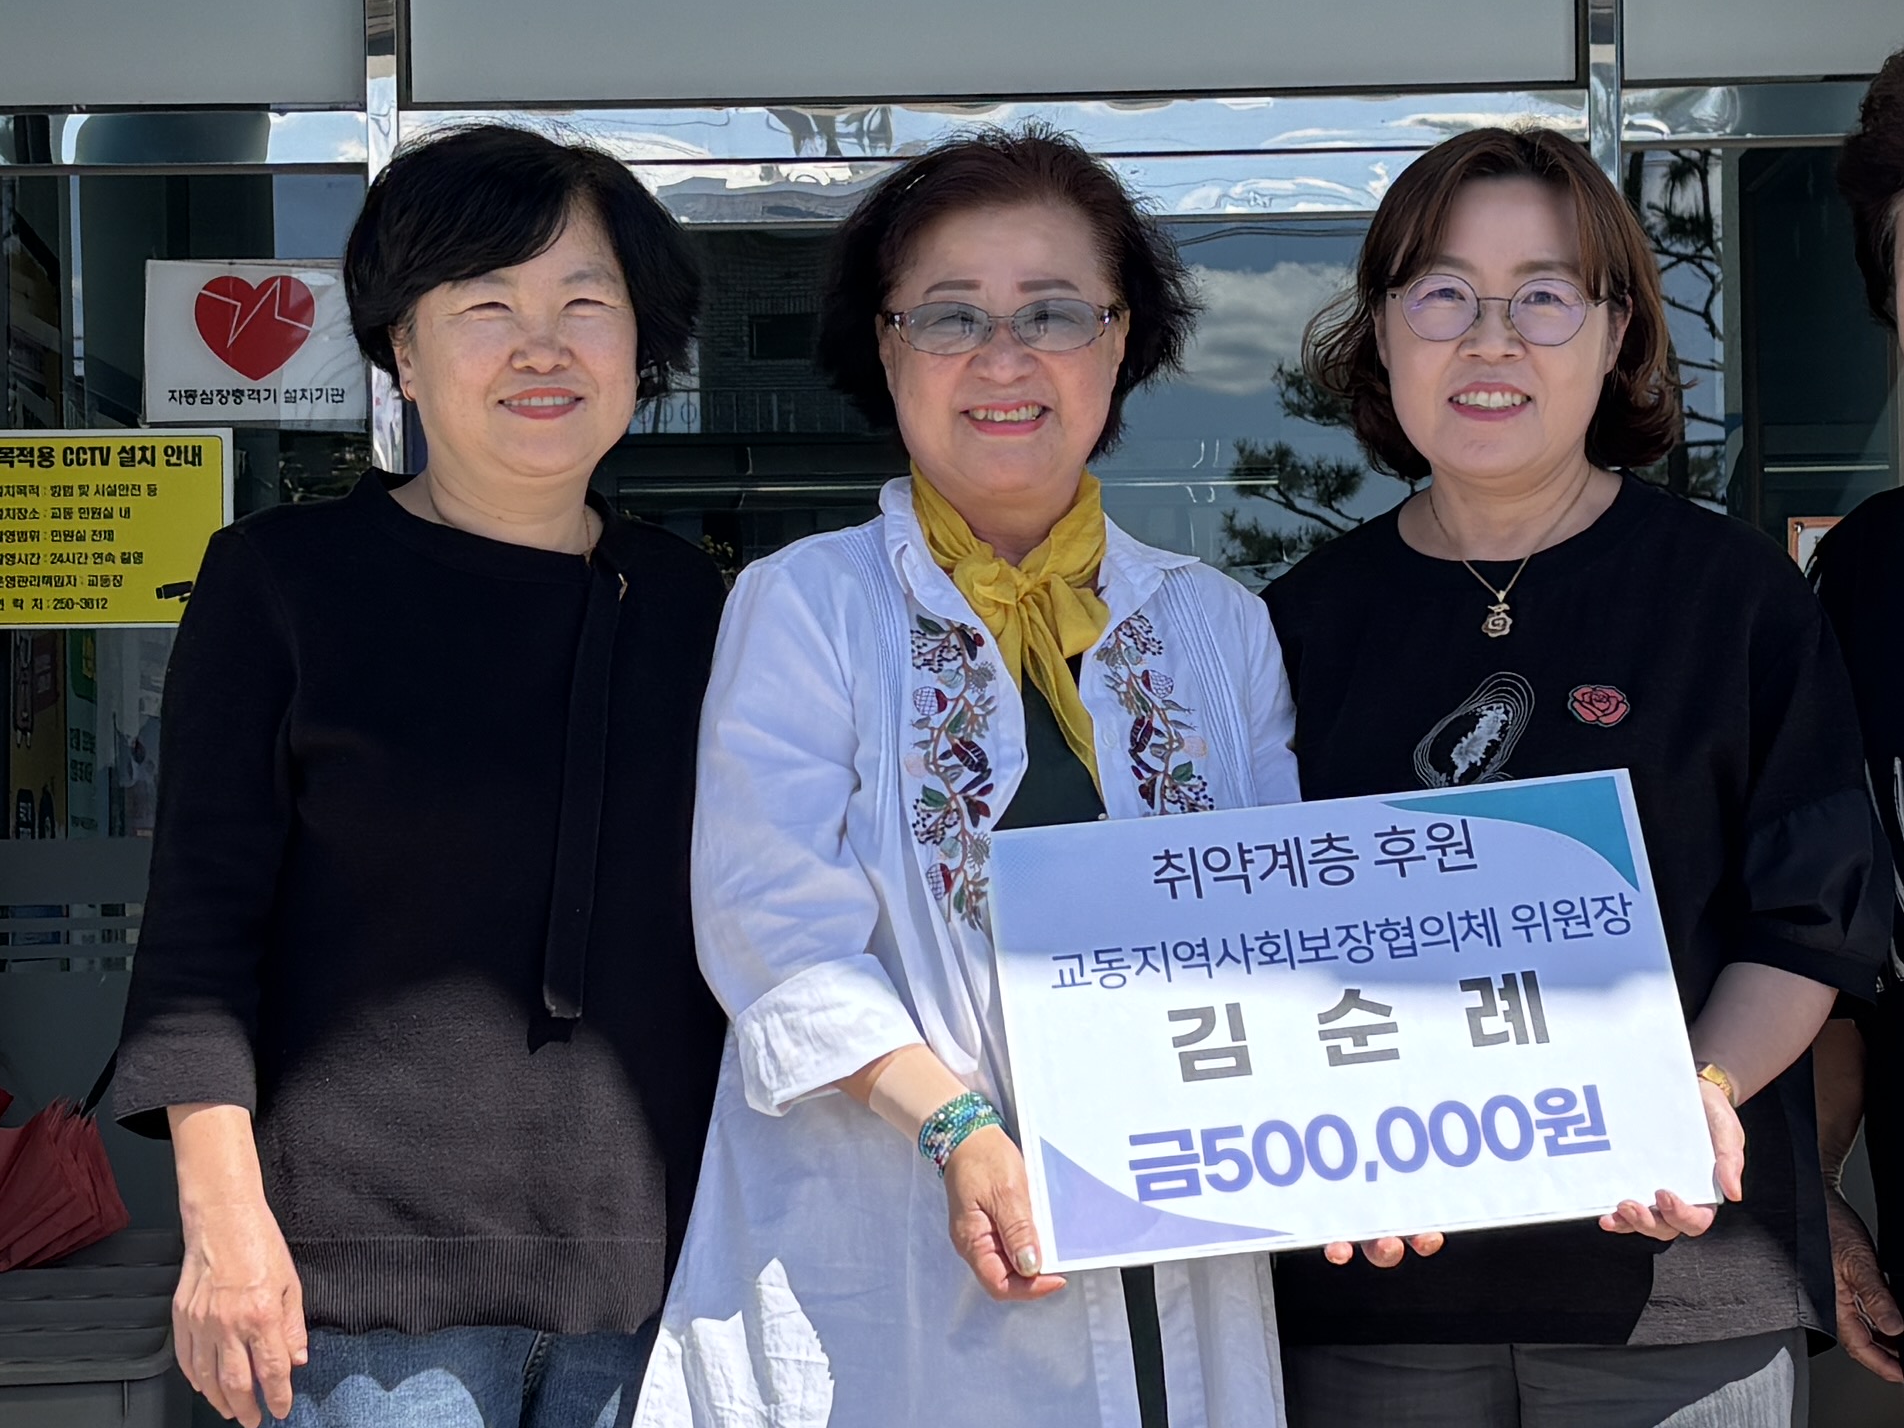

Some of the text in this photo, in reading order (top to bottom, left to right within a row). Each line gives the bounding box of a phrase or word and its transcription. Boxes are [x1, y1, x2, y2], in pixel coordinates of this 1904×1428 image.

[168, 388, 345, 405] 자동심장충격기 설치기관
[62, 446, 111, 466] CCTV
[117, 445, 156, 467] 설치
[163, 444, 203, 467] 안내
[1152, 818, 1479, 900] 취약계층 후원
[1050, 891, 1635, 990] 교동지역사회보장협의체 위원장
[1128, 1083, 1611, 1202] 금500,000원
